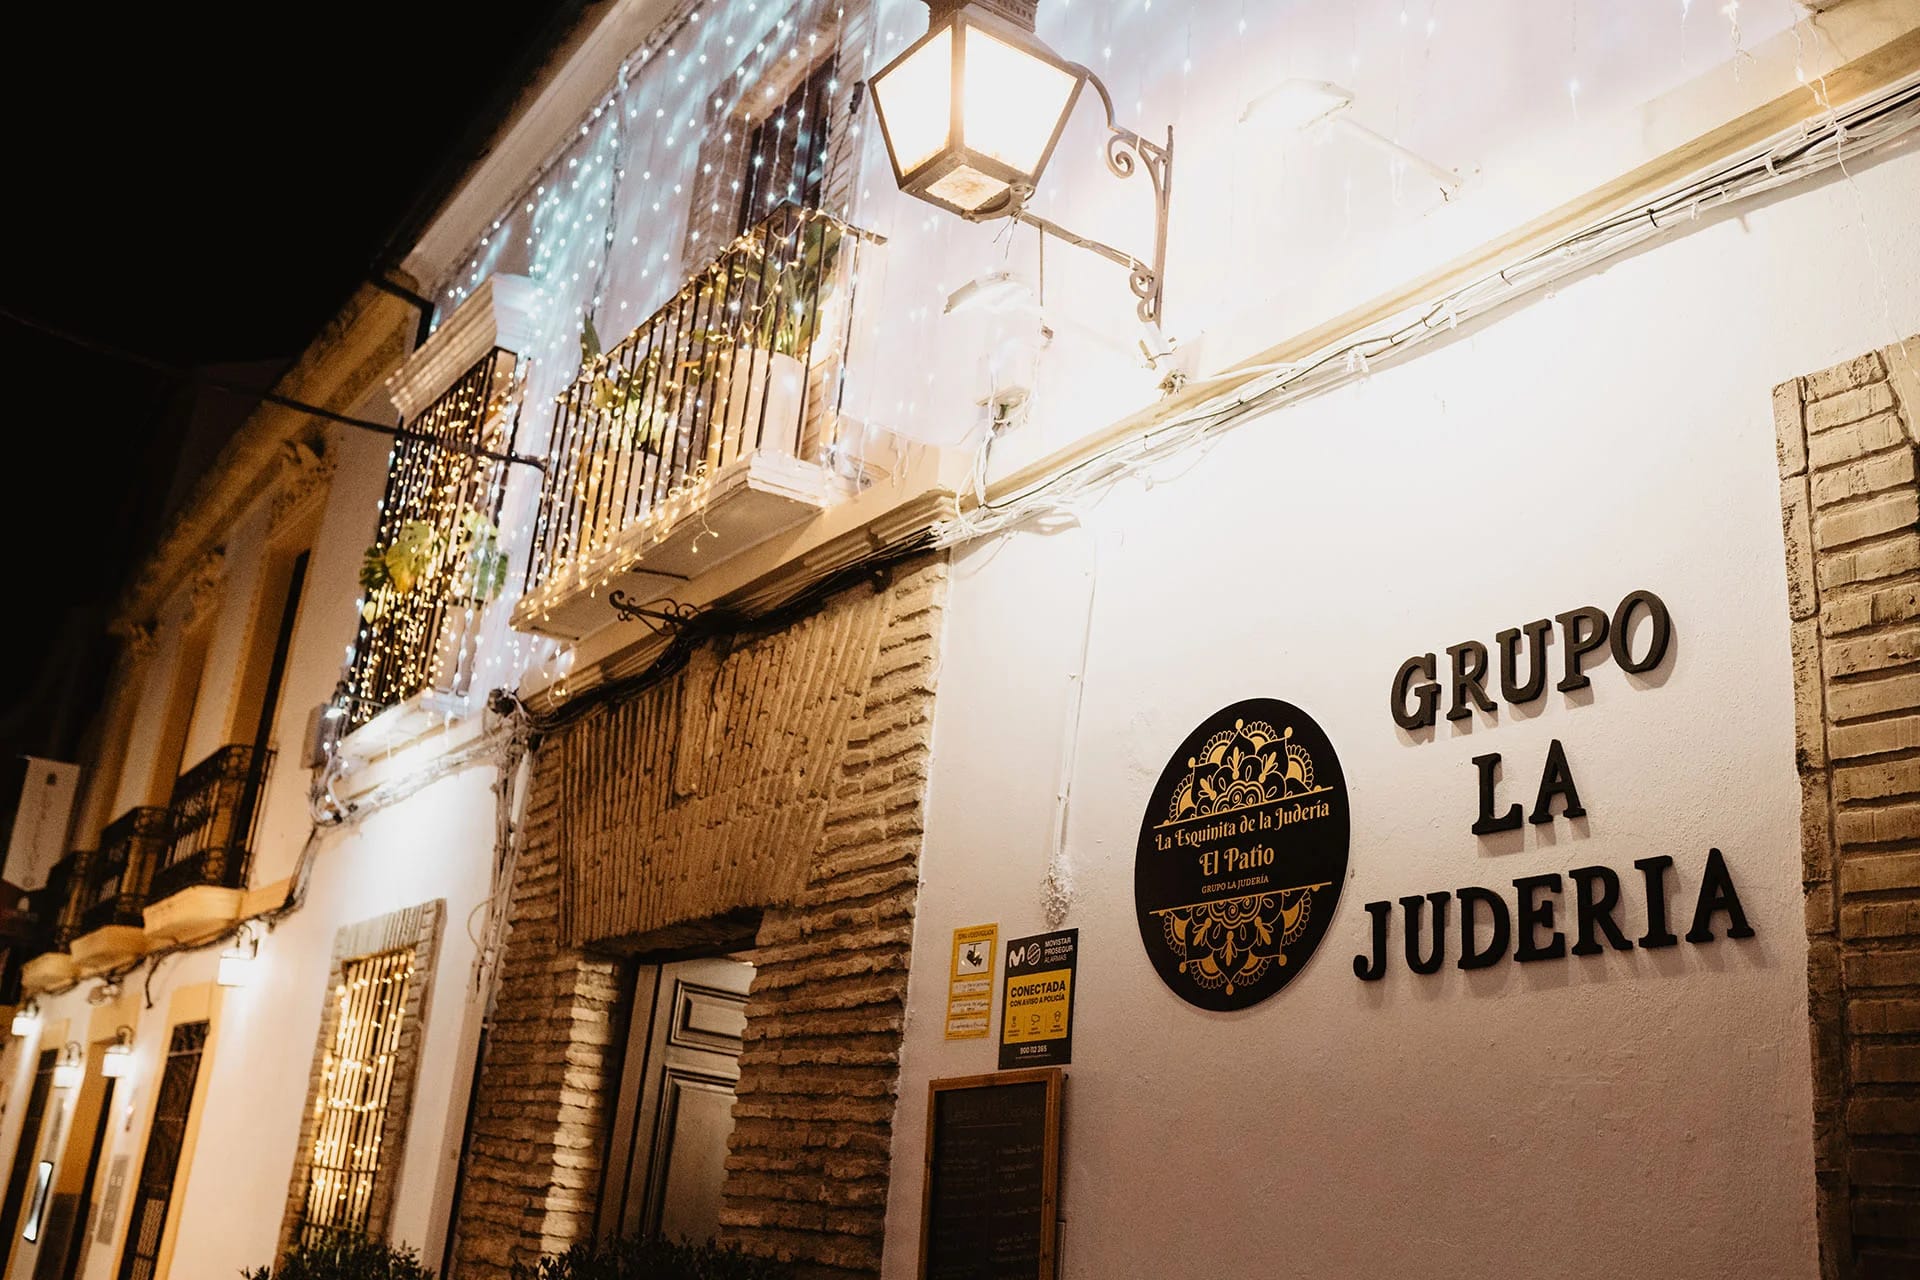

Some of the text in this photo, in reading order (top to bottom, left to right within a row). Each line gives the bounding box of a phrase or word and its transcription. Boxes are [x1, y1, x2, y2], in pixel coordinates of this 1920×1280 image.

[1390, 589, 1671, 731] GRUPO
[1471, 739, 1587, 836] LA
[1154, 800, 1330, 851] La Esquinita de la Judería
[1199, 843, 1275, 876] El Patio
[1201, 874, 1270, 894] GRUPO LA JUDERÍA
[1352, 847, 1756, 981] JUDERIA
[1044, 937, 1072, 947] MOVISTAR
[1044, 945, 1073, 955] PROSEGUR
[1010, 980, 1066, 998] CONECTADA
[1021, 997, 1039, 1006] AVISO
[1043, 992, 1065, 1003] POLICÍA
